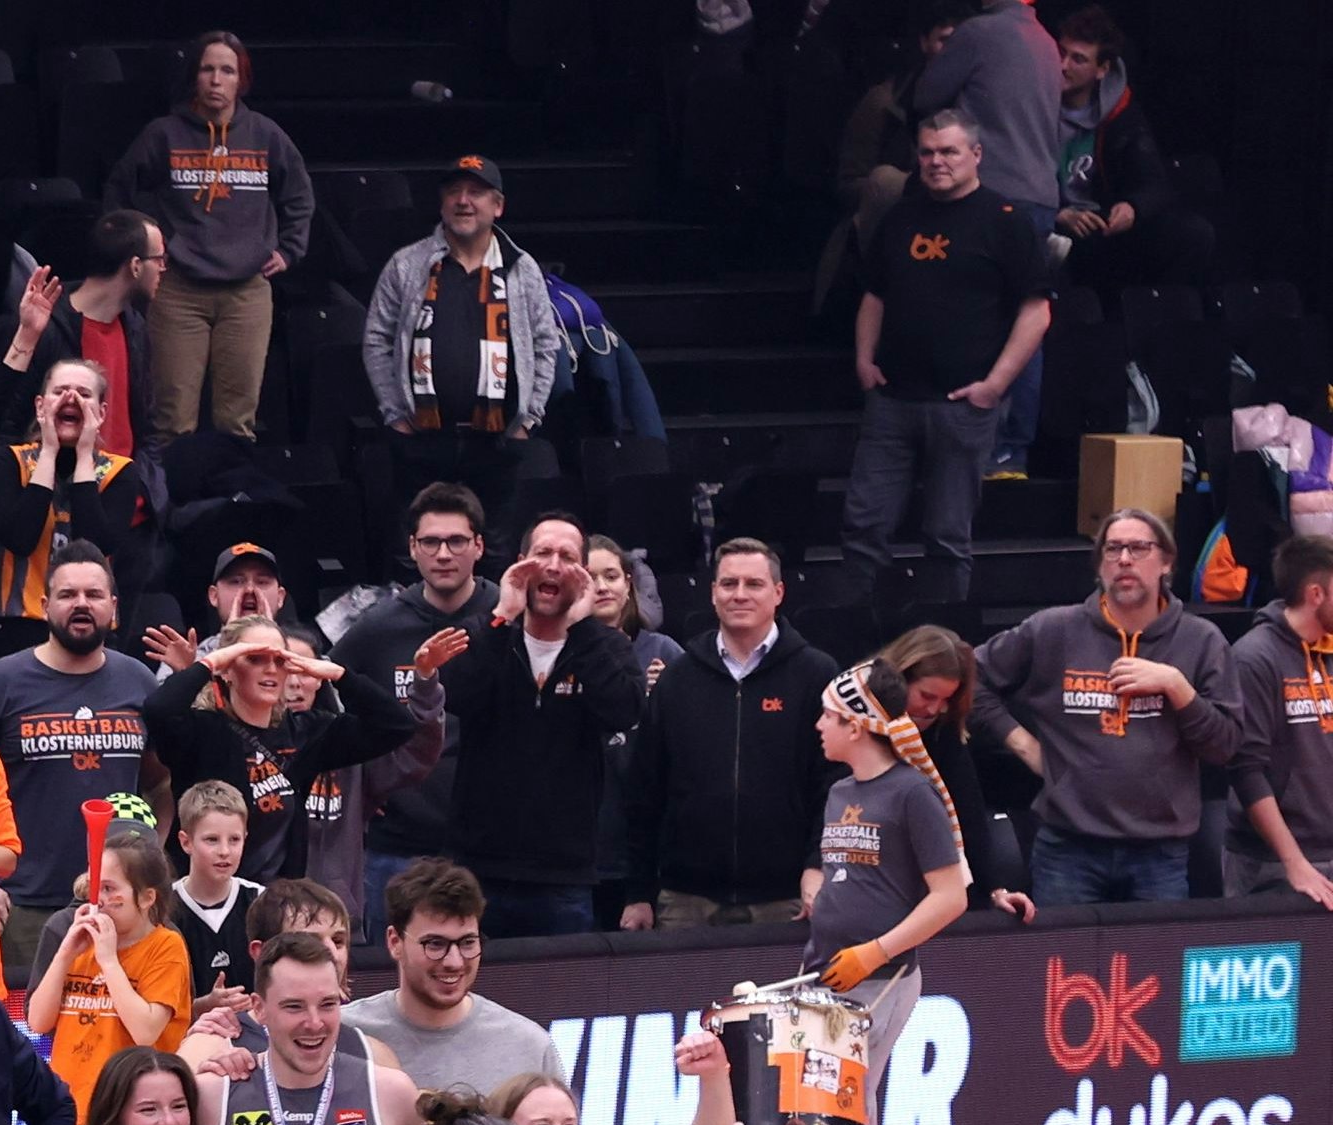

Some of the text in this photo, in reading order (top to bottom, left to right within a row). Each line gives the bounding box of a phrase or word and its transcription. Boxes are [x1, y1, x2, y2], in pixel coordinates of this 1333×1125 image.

[909, 232, 951, 261] bk
[20, 718, 142, 738] BASKETBALL
[21, 734, 145, 755] KLOSTERNEUBURG
[1187, 954, 1293, 1004] IMMO
[1044, 951, 1162, 1073] bk
